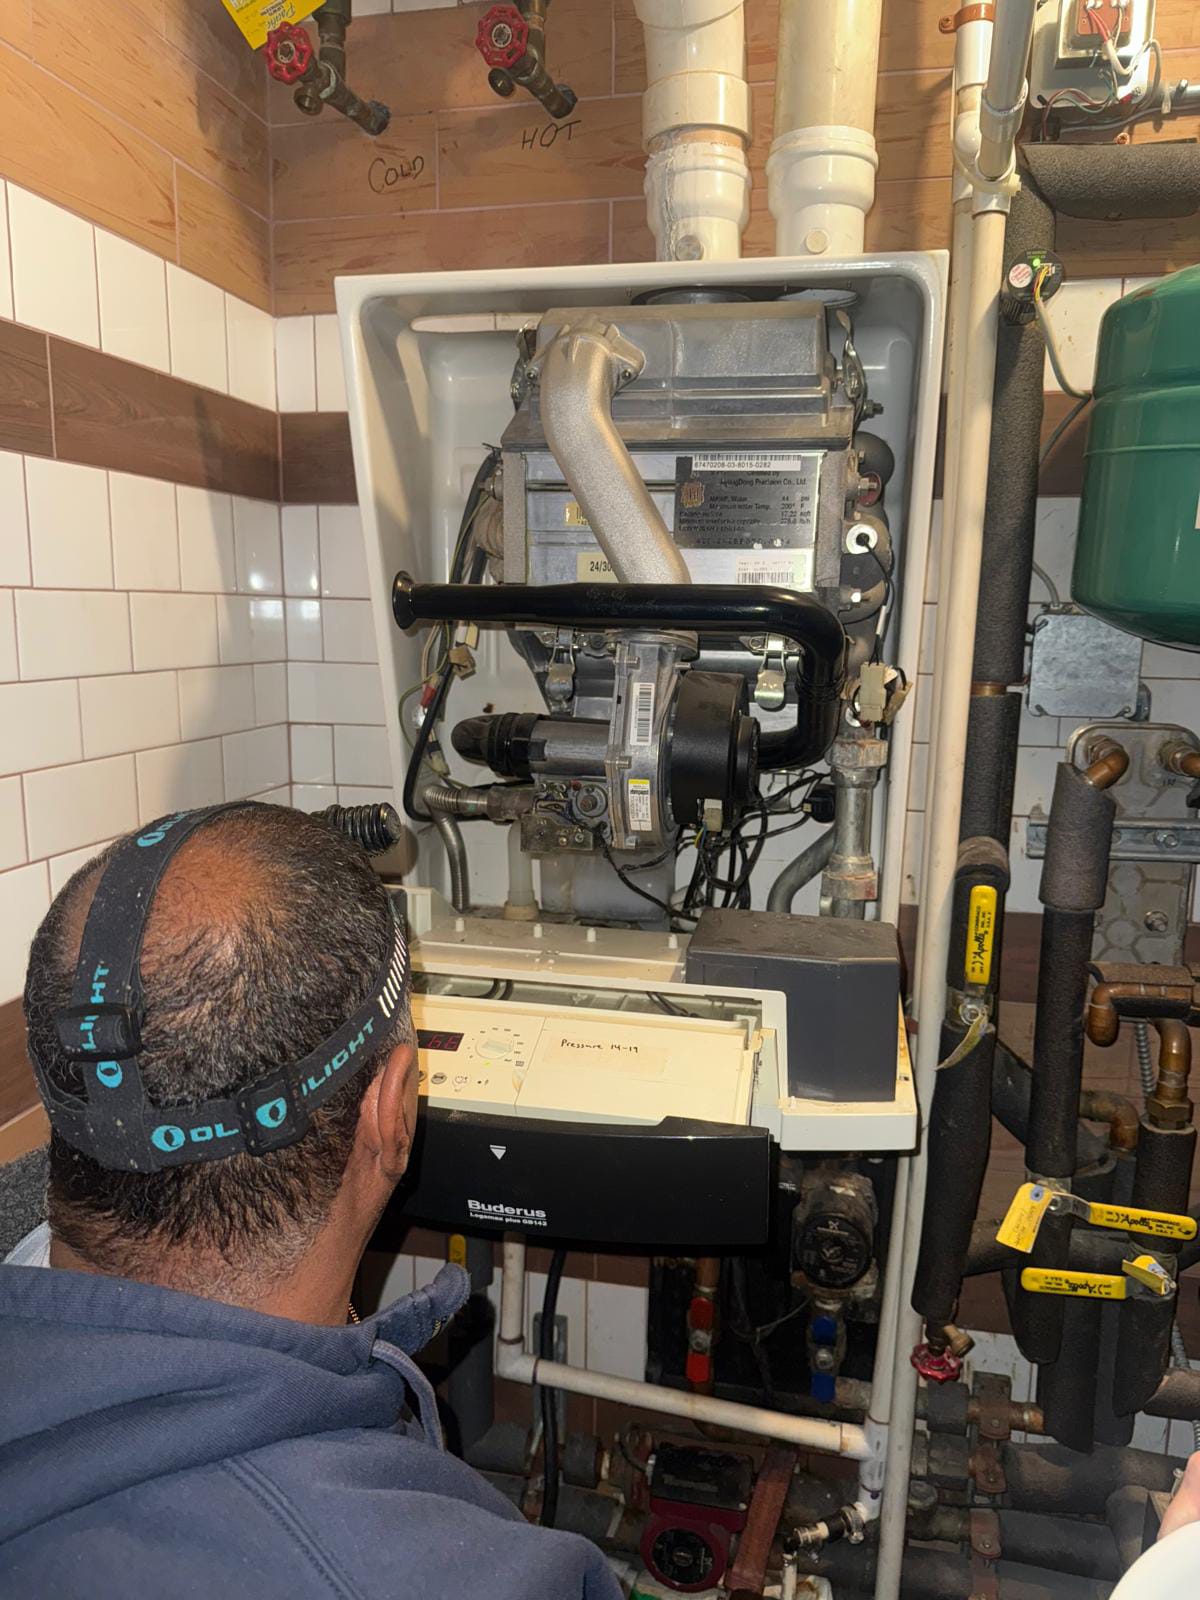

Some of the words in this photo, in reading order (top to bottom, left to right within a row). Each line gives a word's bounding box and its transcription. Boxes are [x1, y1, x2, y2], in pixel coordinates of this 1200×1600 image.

[522, 120, 581, 150] HOT
[368, 156, 425, 194] COLD
[561, 1038, 603, 1050] Pressure
[467, 1199, 547, 1218] Buderus
